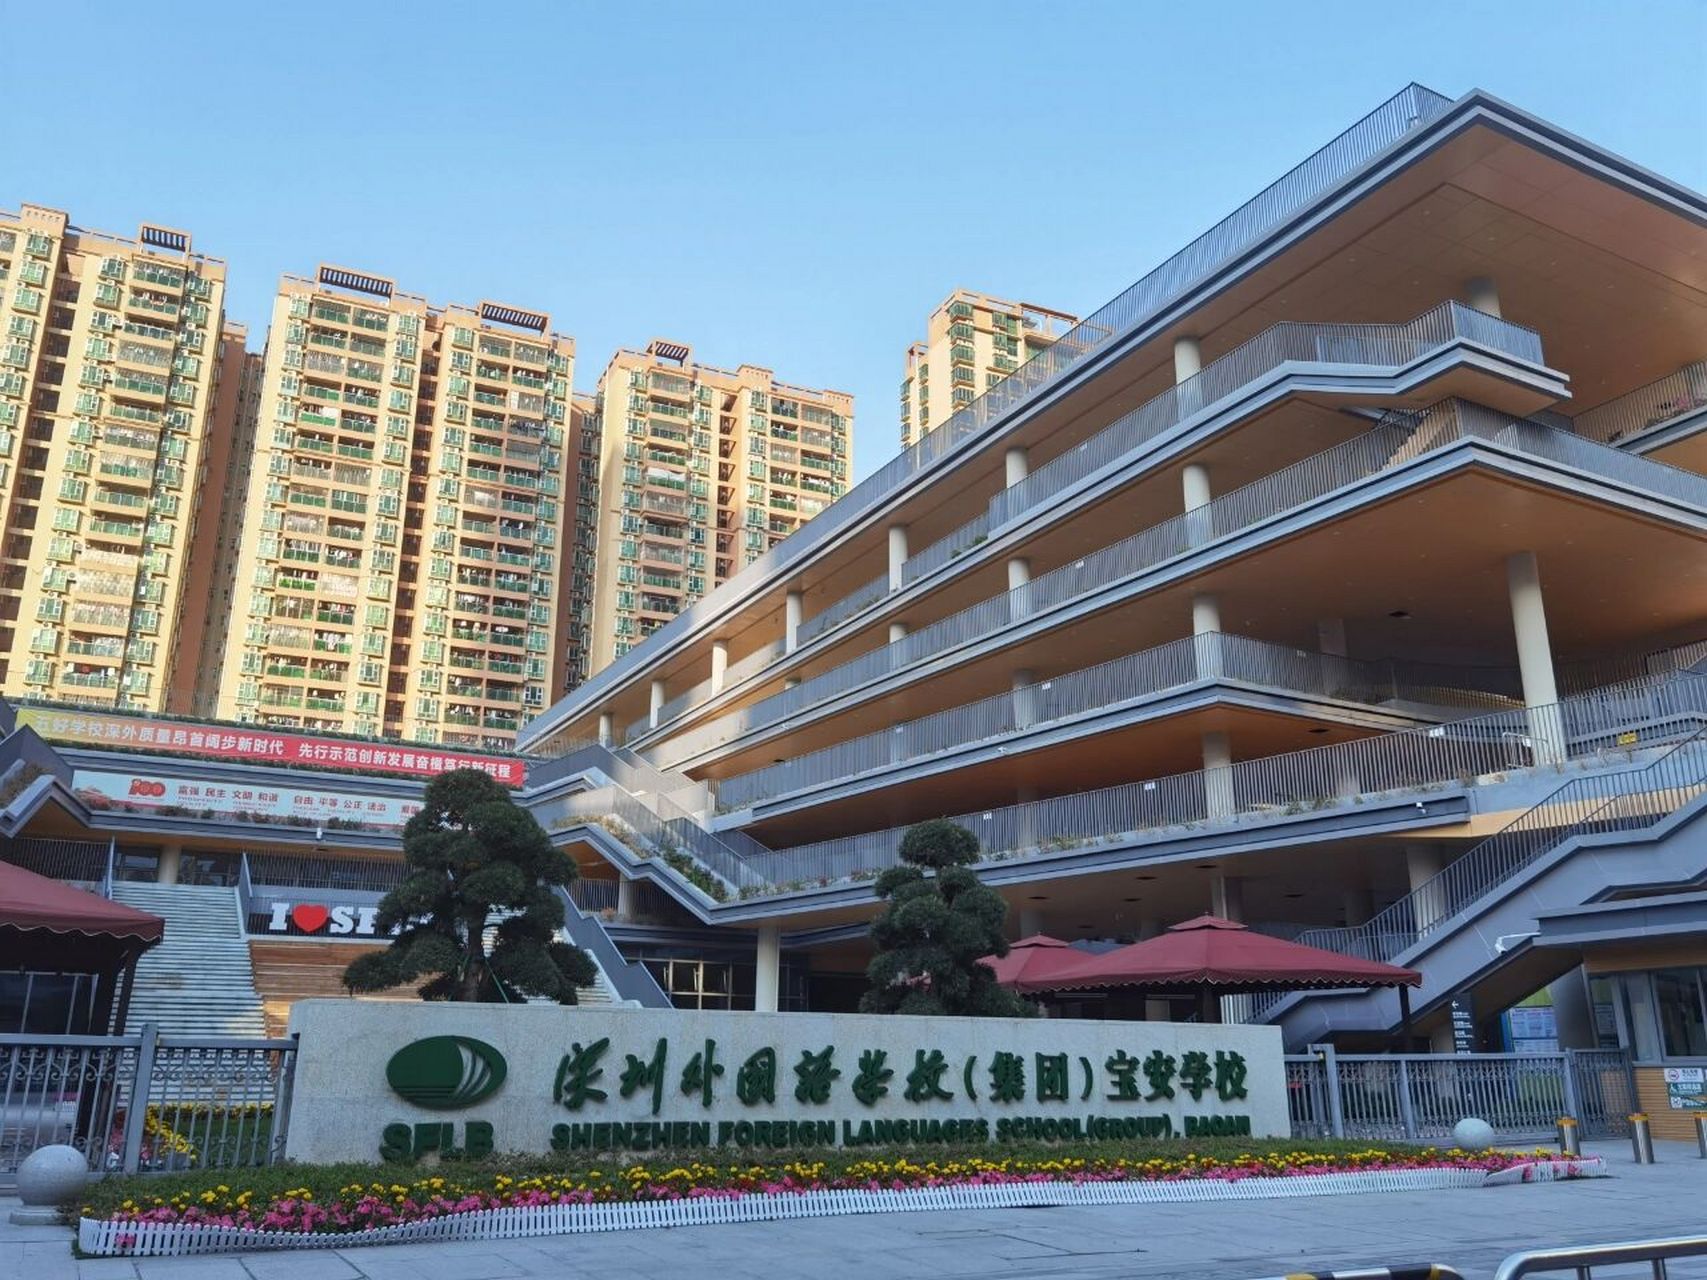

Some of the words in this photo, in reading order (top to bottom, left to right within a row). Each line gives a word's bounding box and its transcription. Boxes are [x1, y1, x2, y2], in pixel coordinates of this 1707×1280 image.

[205, 787, 226, 799] 民主
[232, 790, 253, 801] 文明
[257, 792, 279, 802] 和谐
[294, 795, 314, 806] 自由
[319, 797, 338, 808] 平等
[343, 799, 363, 810] 公正
[269, 902, 290, 931] I
[550, 1121, 711, 1151] SHENZHEN
[717, 1119, 836, 1148] FOREIGN
[842, 1118, 990, 1145] LANGUAGES
